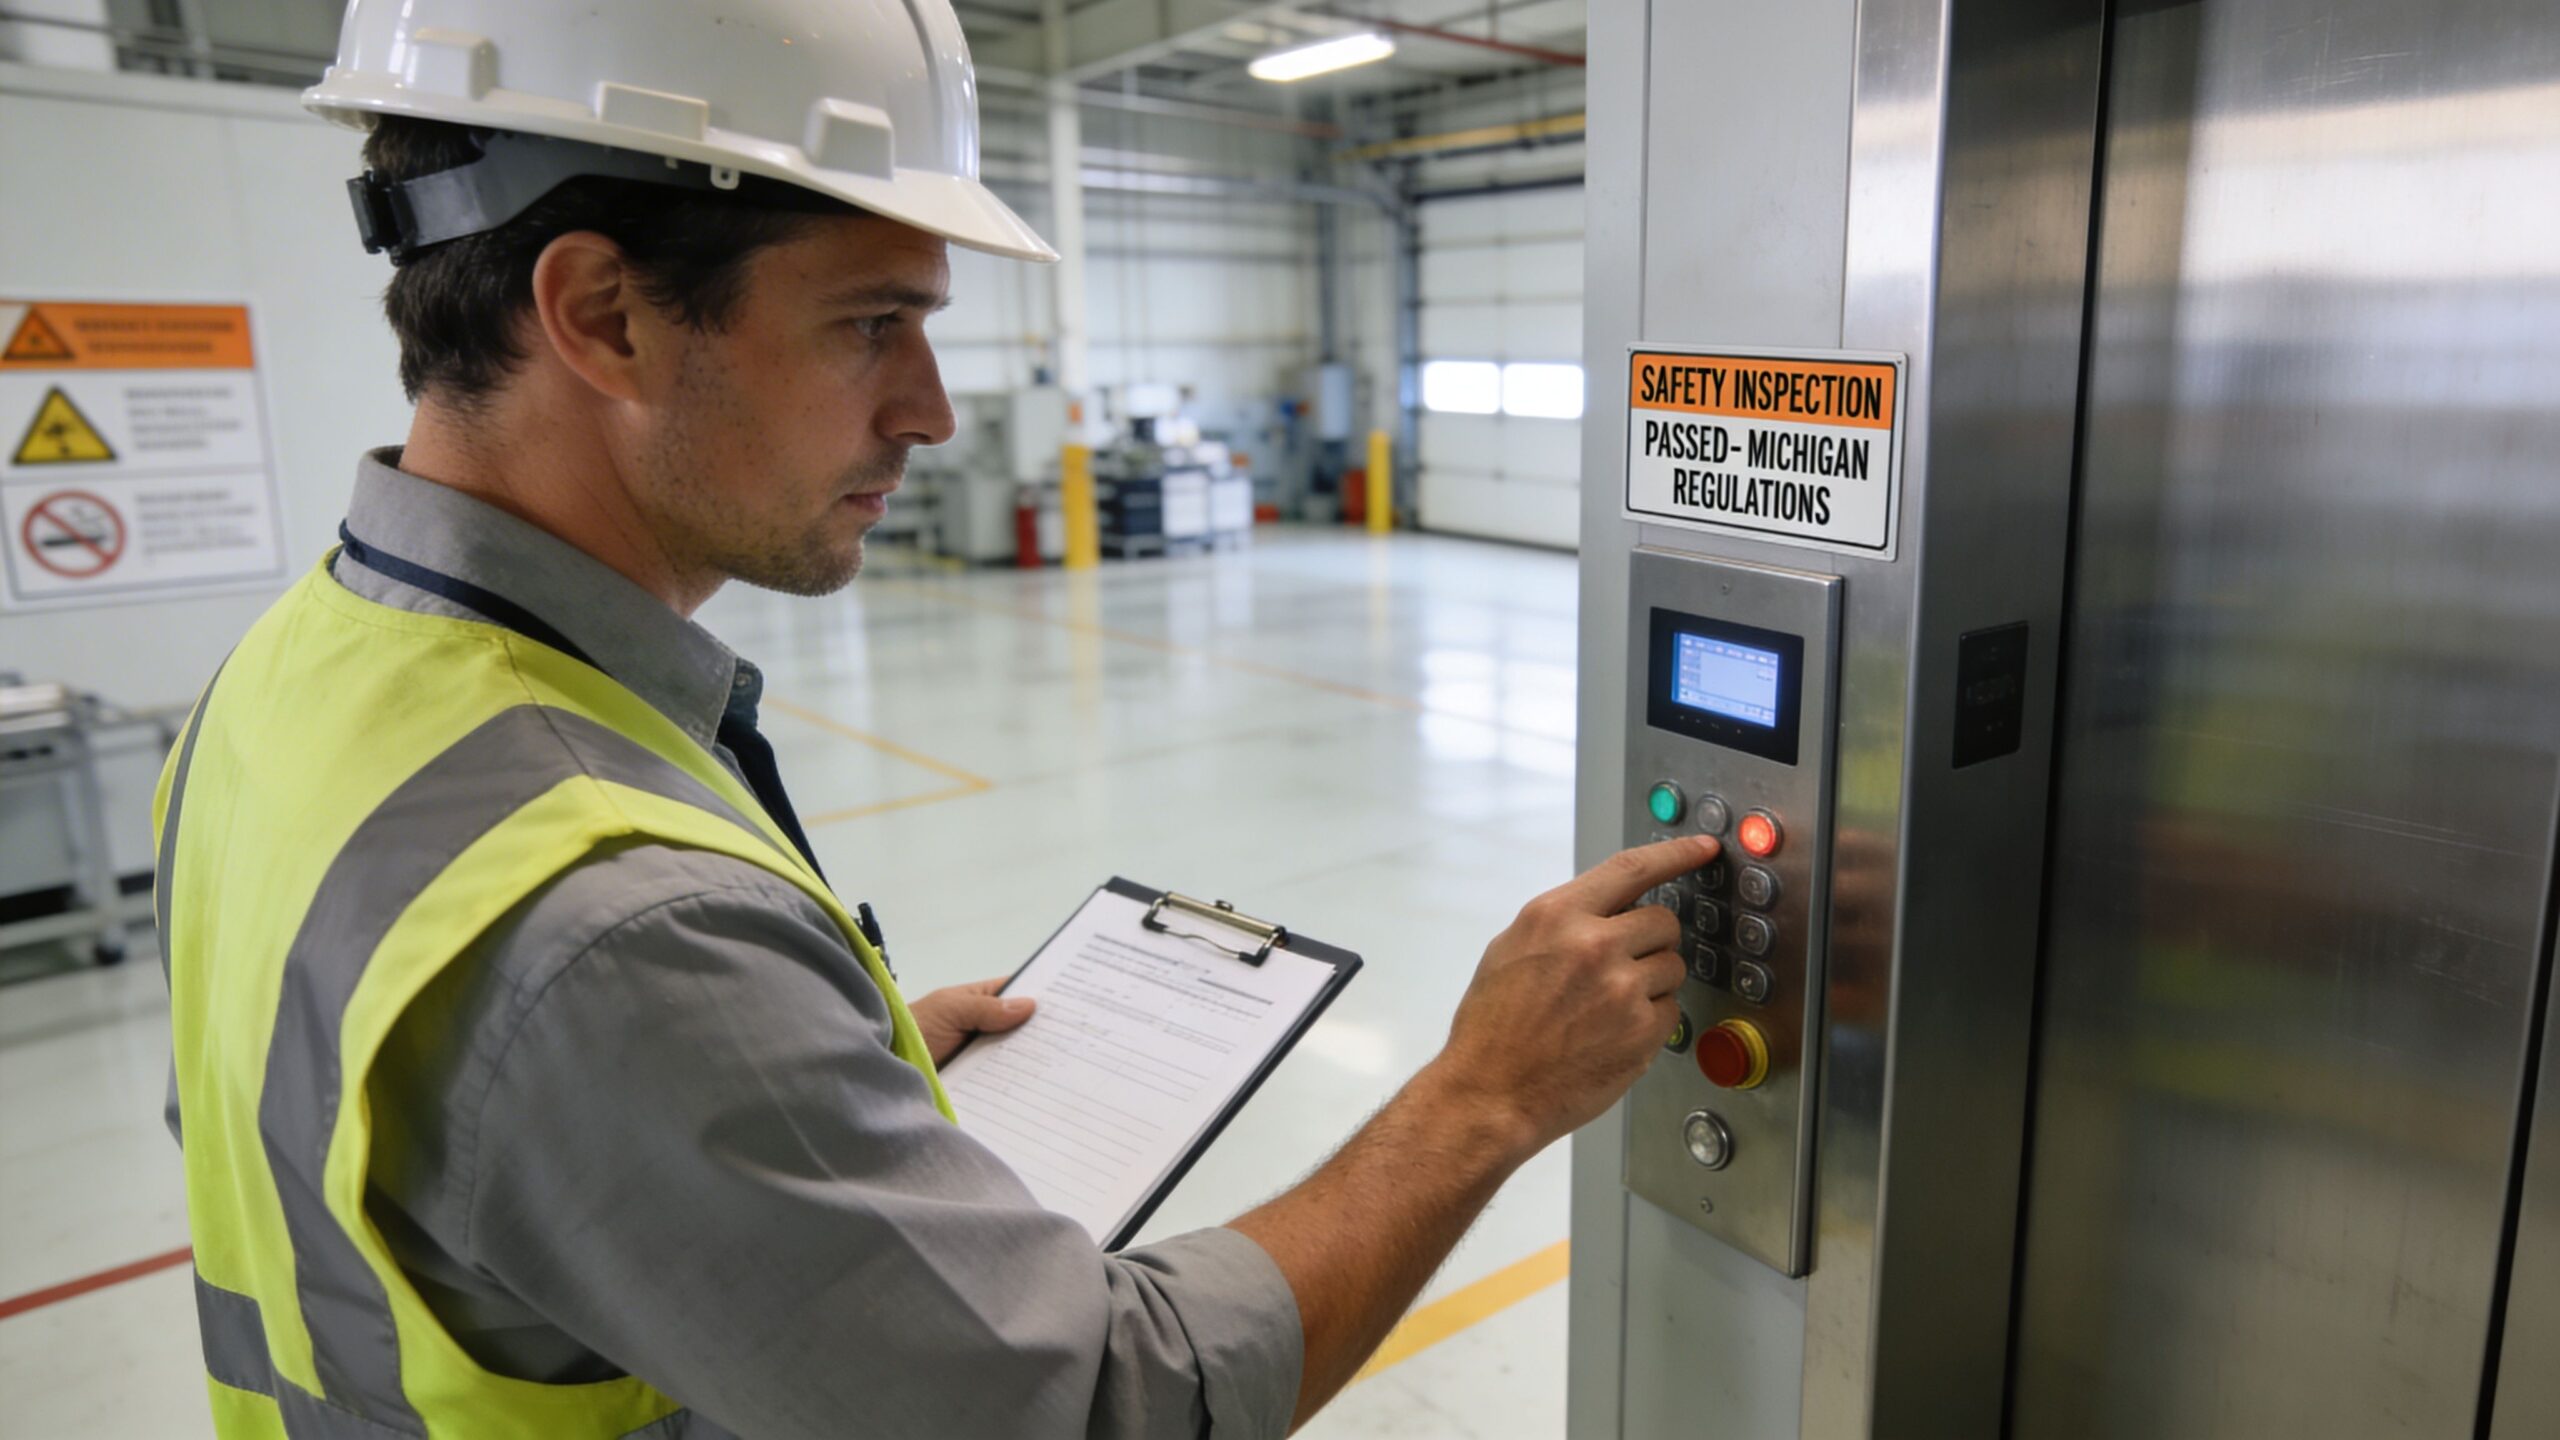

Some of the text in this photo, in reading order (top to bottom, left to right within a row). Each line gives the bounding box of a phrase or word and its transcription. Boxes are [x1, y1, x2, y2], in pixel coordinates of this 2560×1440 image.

[1641, 365, 1882, 420] SAFETY INSPECTION
[1748, 429, 1869, 480] MICHIGAN
[1673, 468, 1830, 525] REGULATIONS
